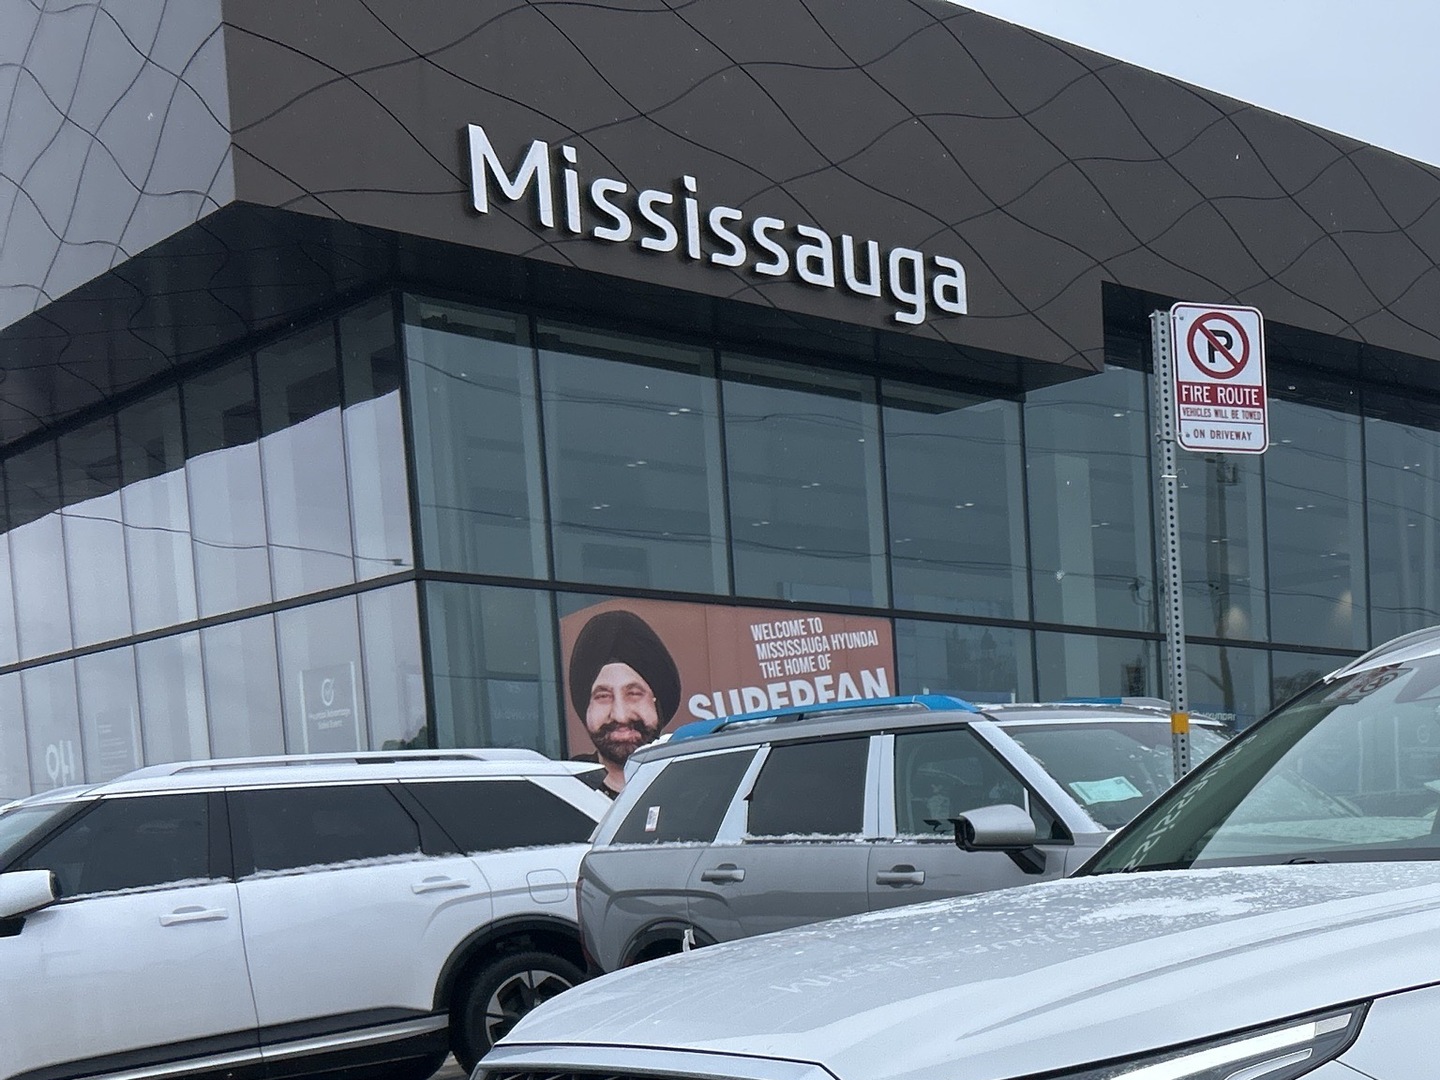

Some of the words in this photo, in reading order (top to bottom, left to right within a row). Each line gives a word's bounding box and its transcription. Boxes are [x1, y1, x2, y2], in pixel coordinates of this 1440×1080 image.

[466, 122, 968, 325] Mississauga
[1182, 385, 1212, 403] FIRE
[1217, 386, 1260, 406] ROUTE
[1182, 407, 1212, 418] VEHICLES
[1214, 409, 1229, 419] WILL
[1231, 409, 1239, 419] BE
[1242, 410, 1261, 420] TOWED
[1193, 429, 1205, 439] ON
[1210, 430, 1252, 440] DRIVEWAY
[750, 619, 807, 641] WELCOME
[807, 617, 823, 634] TO
[756, 635, 831, 660] MISSISSAUGA
[831, 630, 879, 650] HYUNDAI
[759, 661, 784, 679] THE
[784, 656, 817, 676] HOME
[818, 654, 832, 671] OF
